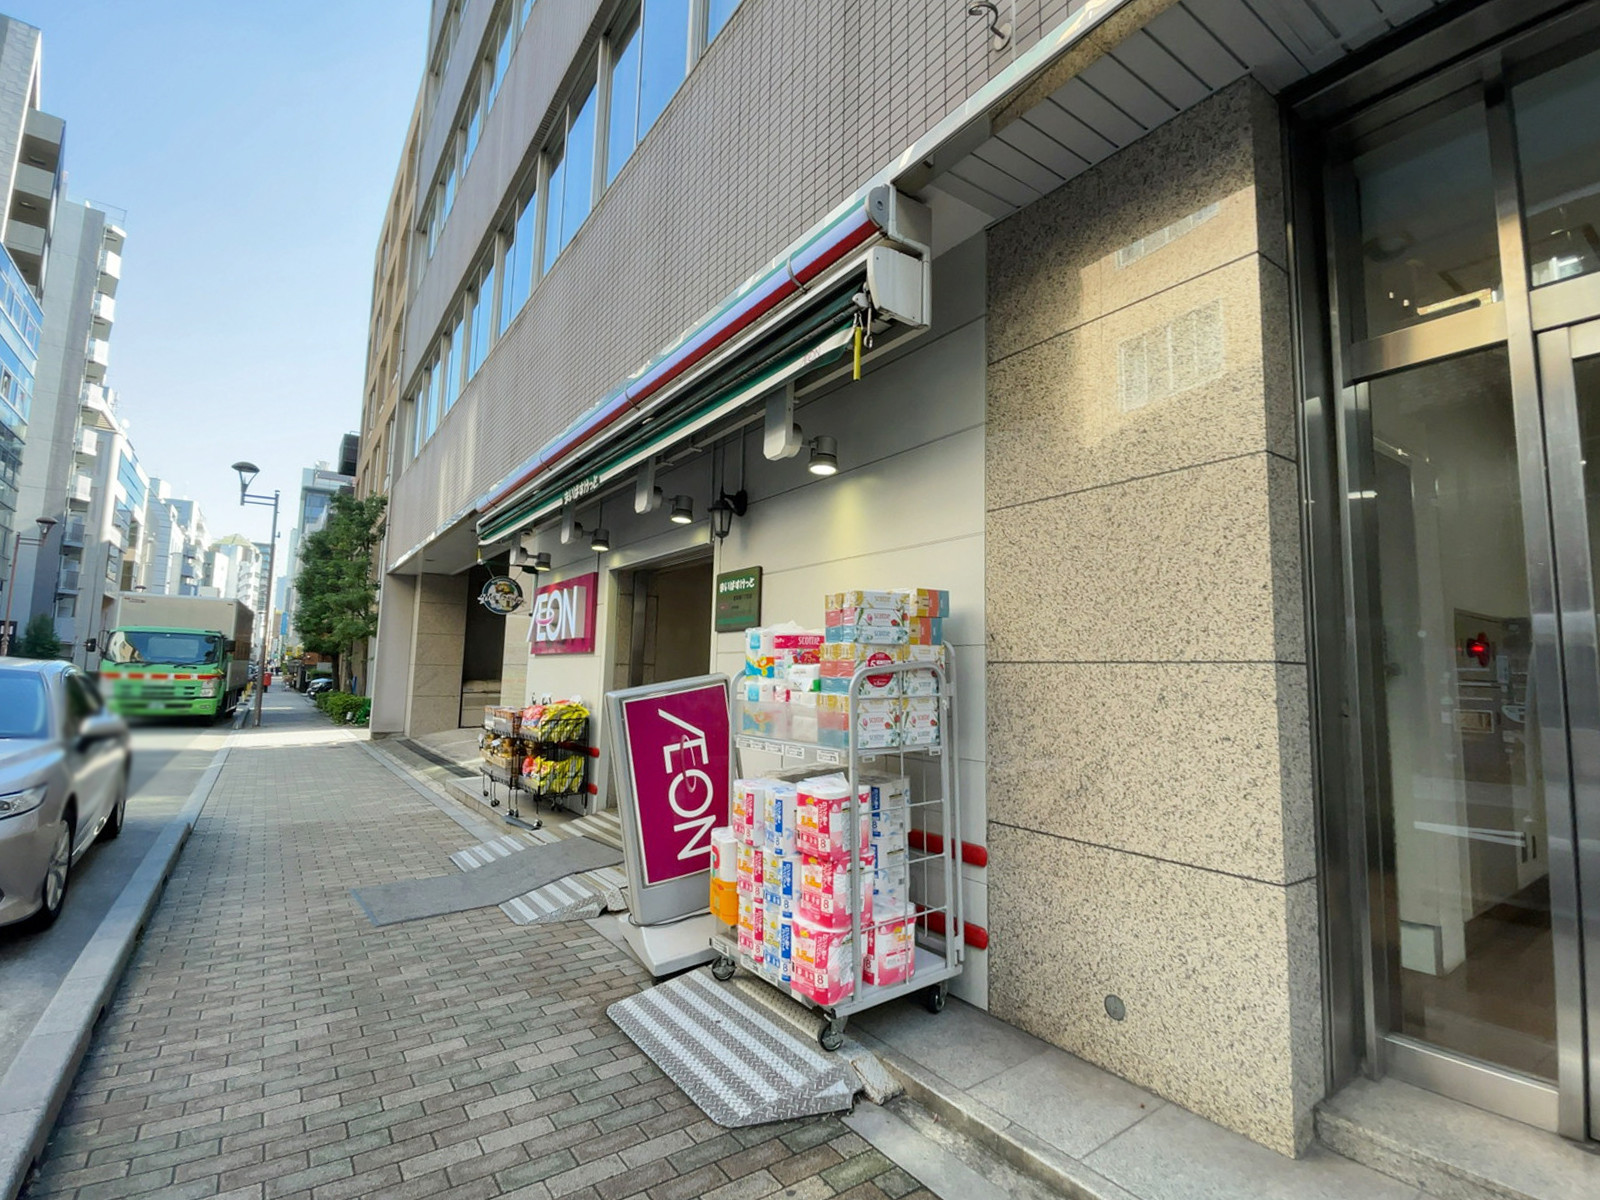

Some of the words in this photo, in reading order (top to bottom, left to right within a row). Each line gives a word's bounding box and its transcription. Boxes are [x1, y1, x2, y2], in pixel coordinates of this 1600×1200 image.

[720, 577, 755, 593] まいばすけっと
